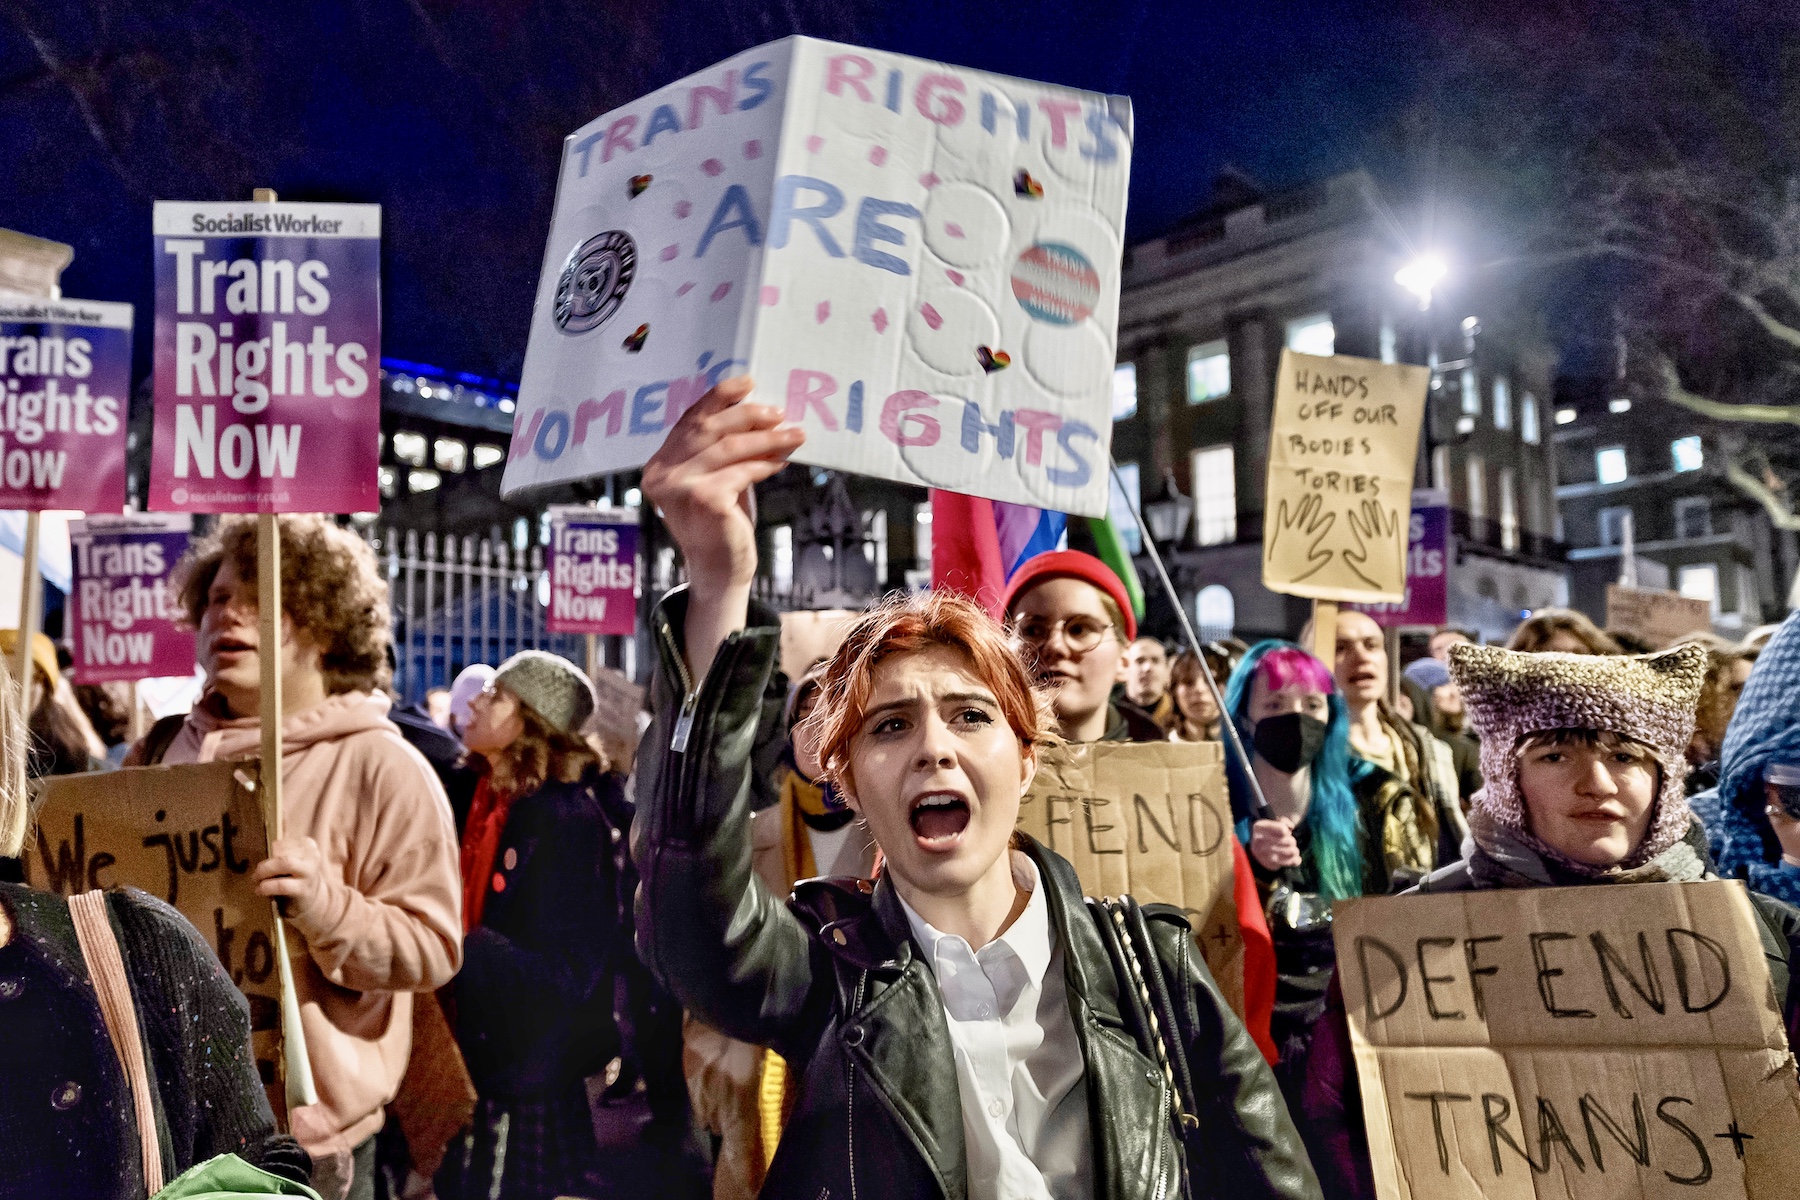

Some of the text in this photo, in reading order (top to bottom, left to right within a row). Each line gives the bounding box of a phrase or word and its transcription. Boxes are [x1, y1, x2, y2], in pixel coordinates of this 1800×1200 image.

[572, 53, 1119, 178] TRANS RIGHTS
[192, 212, 343, 234] Socialist Worker
[695, 173, 923, 276] ARE
[165, 239, 330, 316] Trans
[0, 335, 93, 378] rans
[176, 322, 369, 414] Rights
[1296, 369, 1369, 399] HANDS
[785, 367, 1099, 487] RIGHTS
[1299, 400, 1398, 425] OFF OUR
[0, 435, 67, 489] ow
[174, 404, 302, 479] Now
[1289, 434, 1371, 456] BODIES
[1295, 467, 1380, 496] TORIES
[72, 536, 166, 576] Trans
[552, 521, 619, 554] Trans
[554, 554, 633, 595] Rights
[553, 587, 607, 621] Now
[83, 623, 154, 665] Now
[1020, 792, 1224, 857] FEND
[33, 809, 249, 905] We just
[1354, 927, 1732, 1023] DEFEND
[1404, 1091, 1755, 1186] TRANS+
